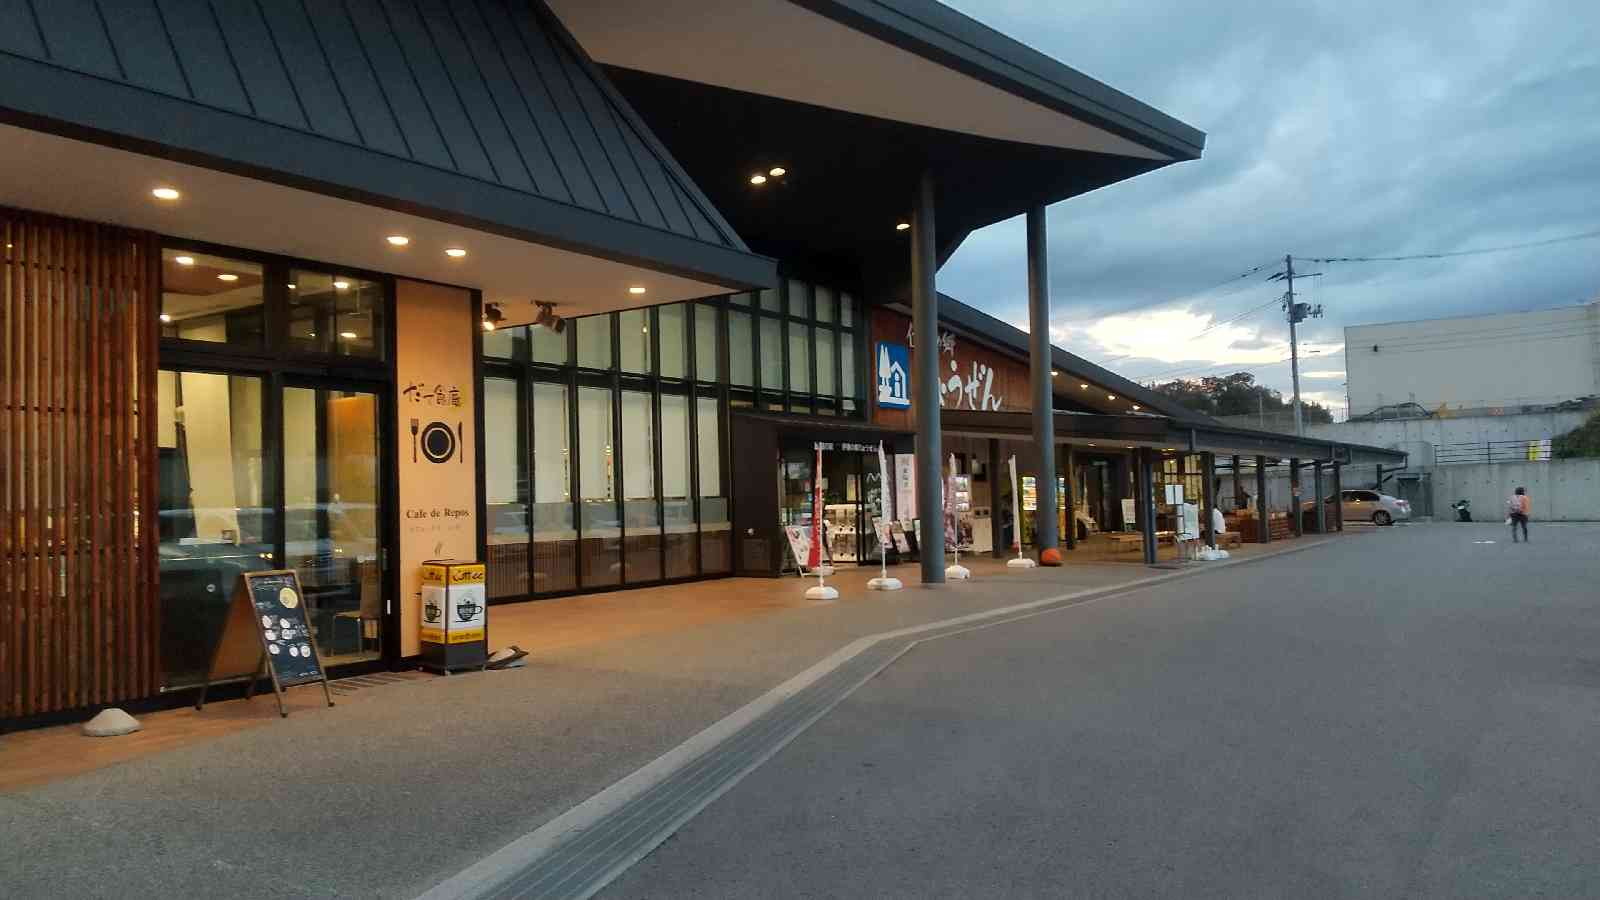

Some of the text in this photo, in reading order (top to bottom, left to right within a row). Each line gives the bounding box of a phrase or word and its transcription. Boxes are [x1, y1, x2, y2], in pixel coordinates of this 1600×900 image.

[405, 508, 469, 519] Cafe de Repos
